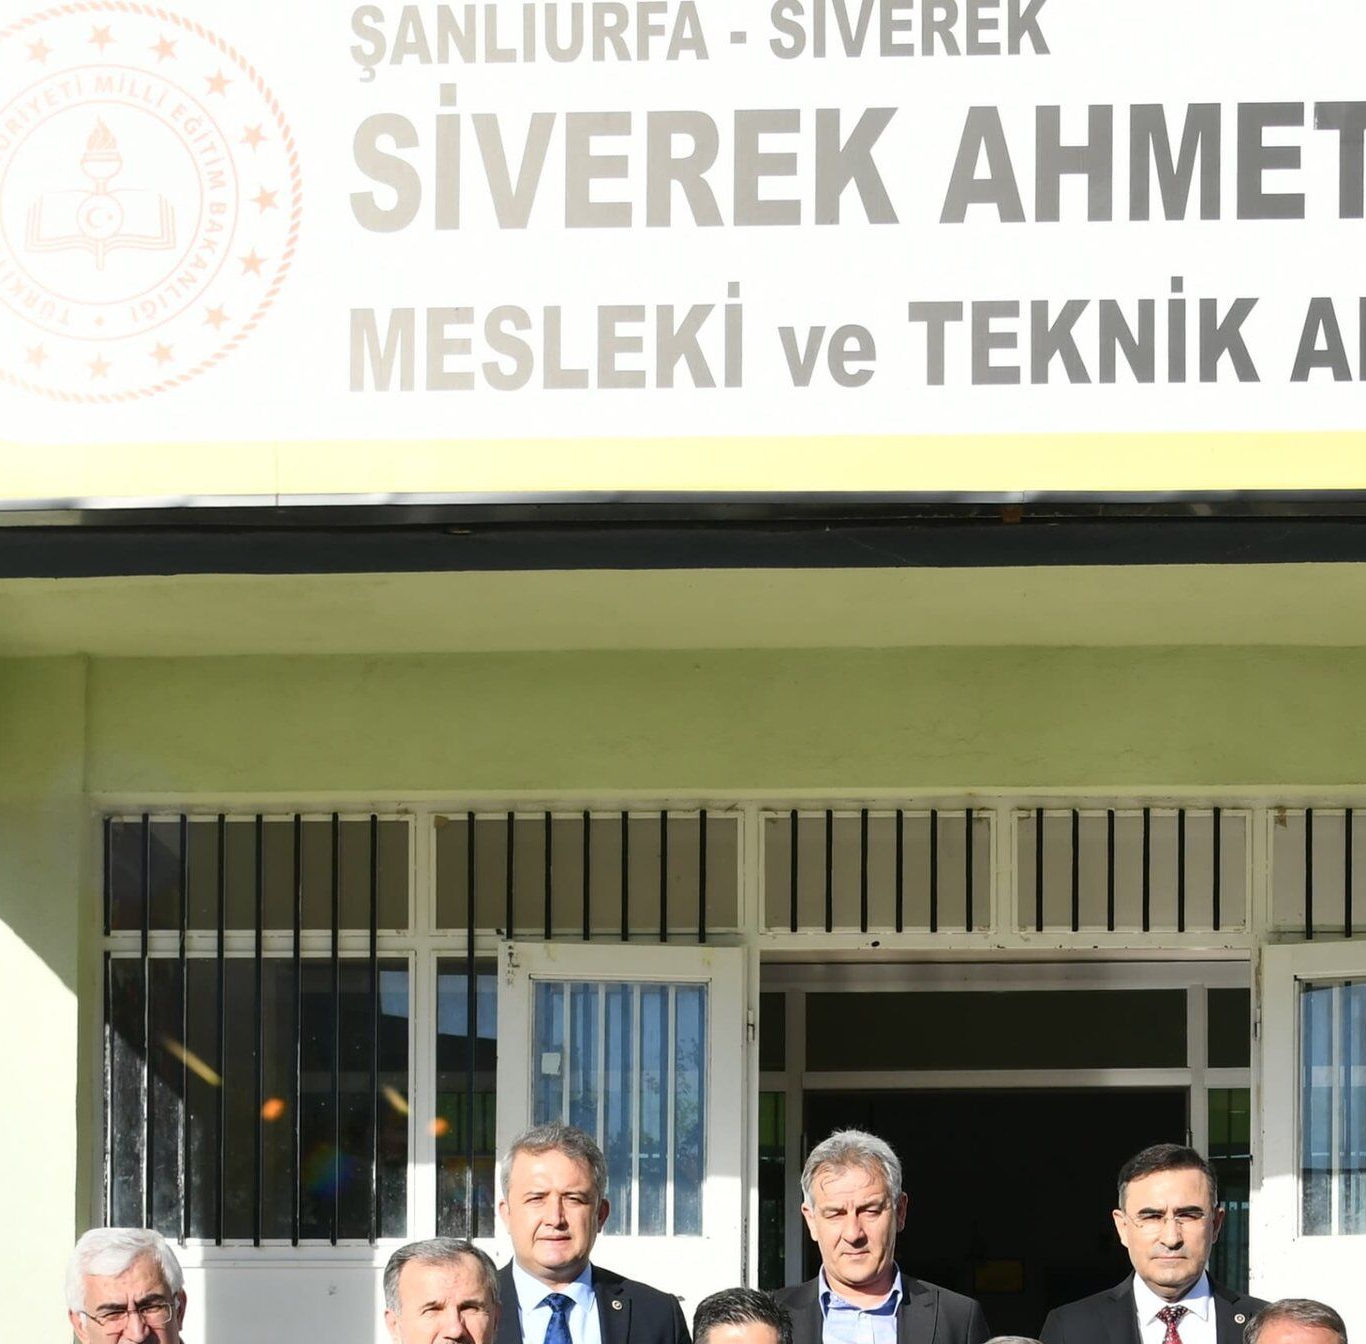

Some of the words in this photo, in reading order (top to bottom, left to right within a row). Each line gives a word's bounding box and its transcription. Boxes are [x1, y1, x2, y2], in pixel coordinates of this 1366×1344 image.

[94, 73, 169, 108] MİLLİ
[350, 0, 709, 82] ŞANLIURFA
[730, 31, 747, 44] -
[170, 103, 227, 190] EĞİTİM
[350, 83, 900, 233] SİVEREK
[130, 201, 227, 322] BAKANLIĞI
[350, 281, 743, 391] MESLEKİ
[777, 324, 876, 388] ve
[908, 276, 1261, 386] TEKNİK
